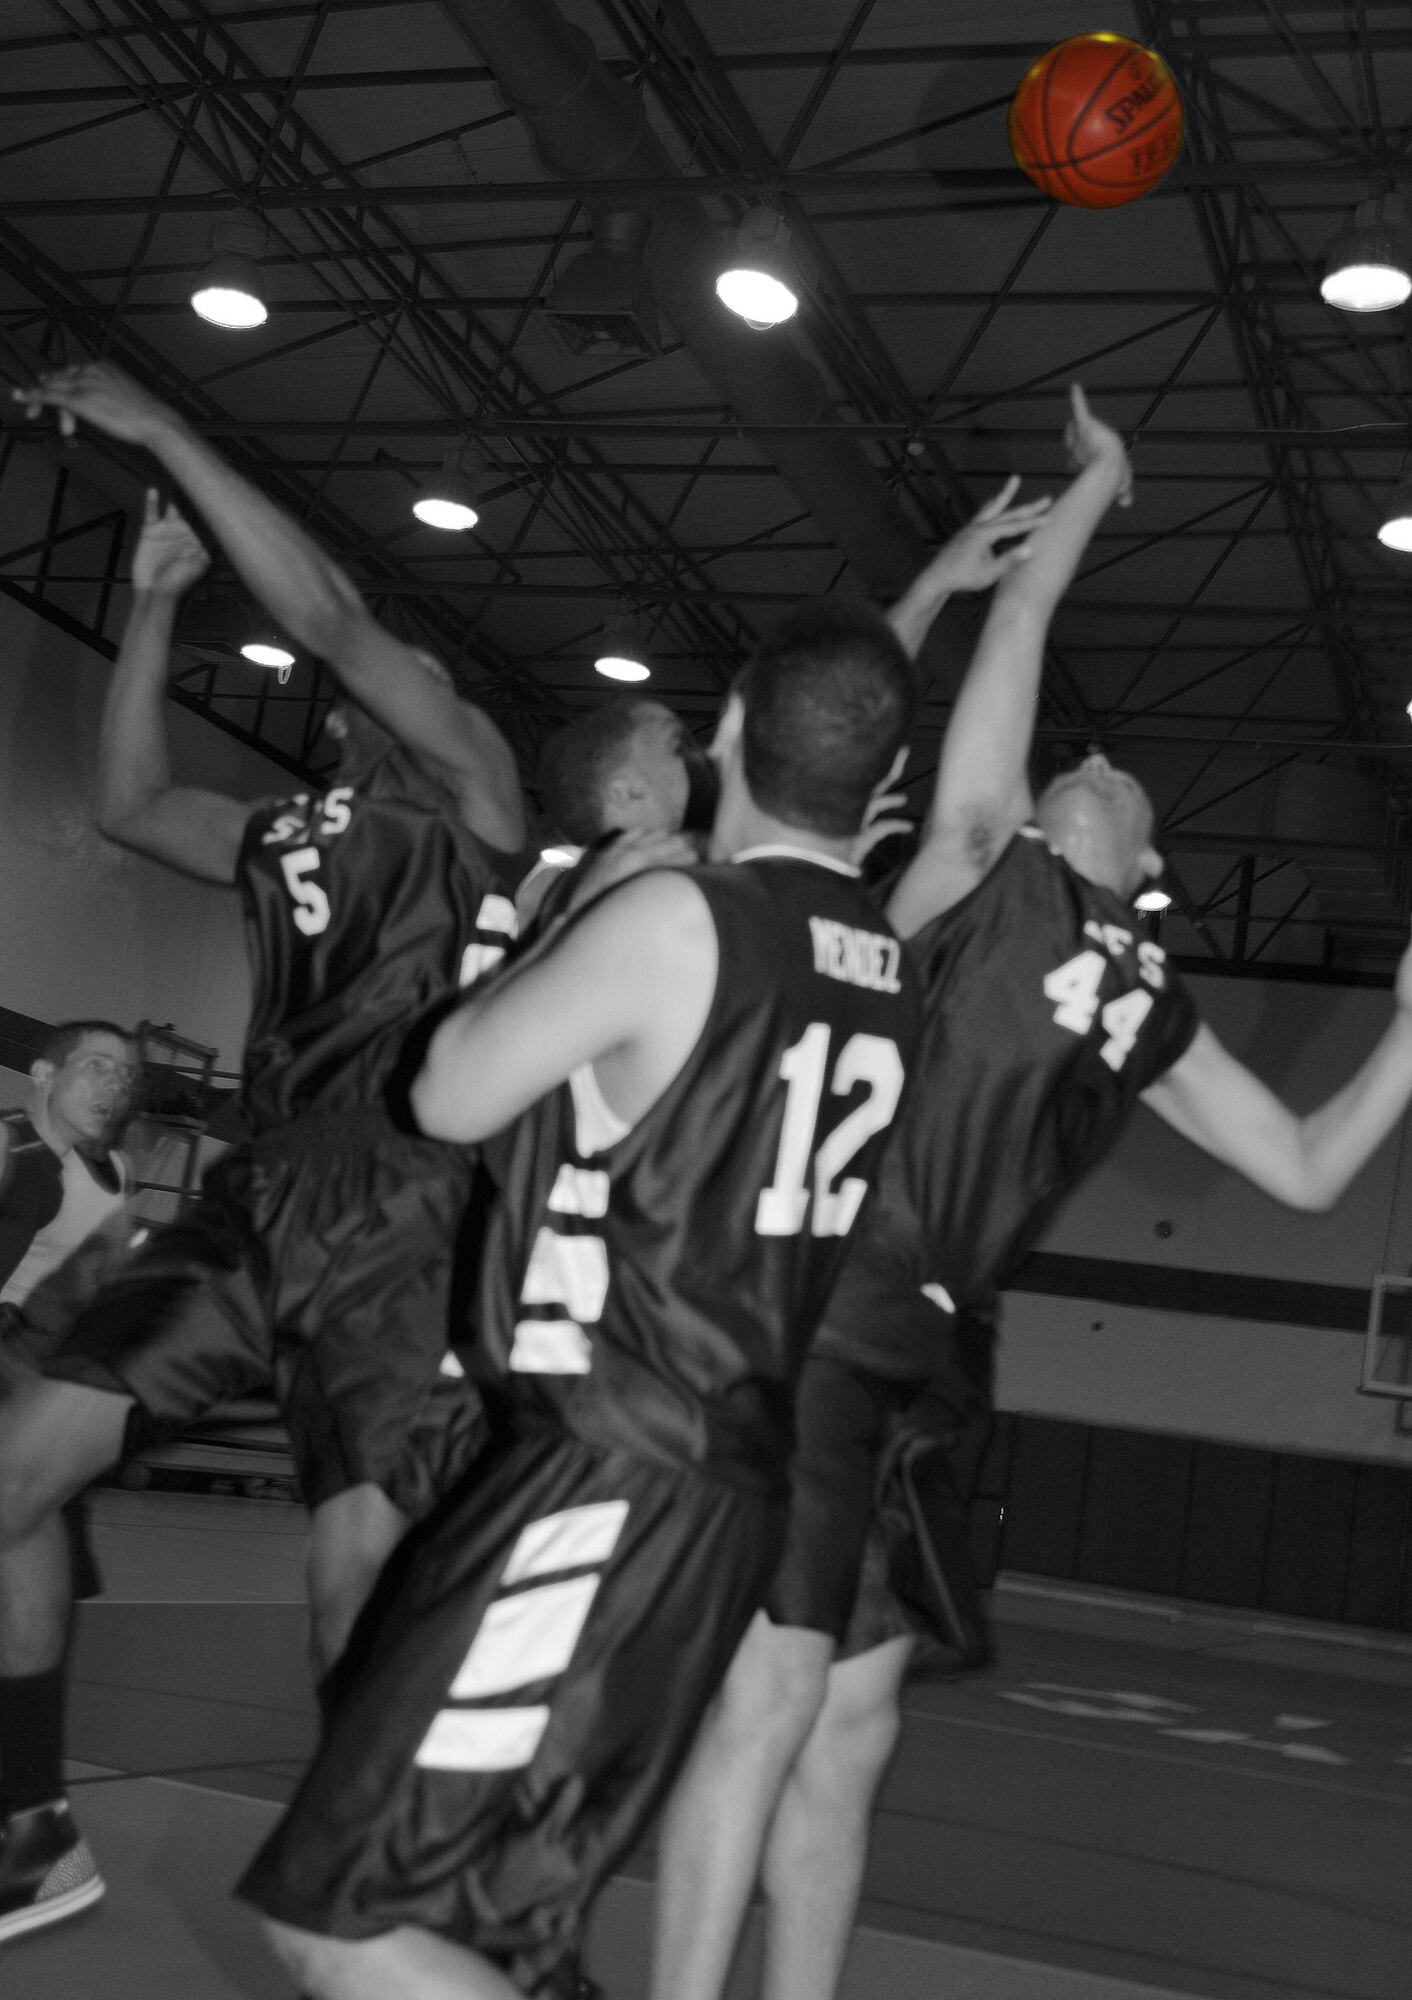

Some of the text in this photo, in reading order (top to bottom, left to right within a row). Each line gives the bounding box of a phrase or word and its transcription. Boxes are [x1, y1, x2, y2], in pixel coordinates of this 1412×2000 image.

[280, 847, 331, 936] 5
[808, 915, 902, 994] MENDEZ
[1044, 950, 1154, 1072] 44
[755, 1022, 905, 1237] 12
